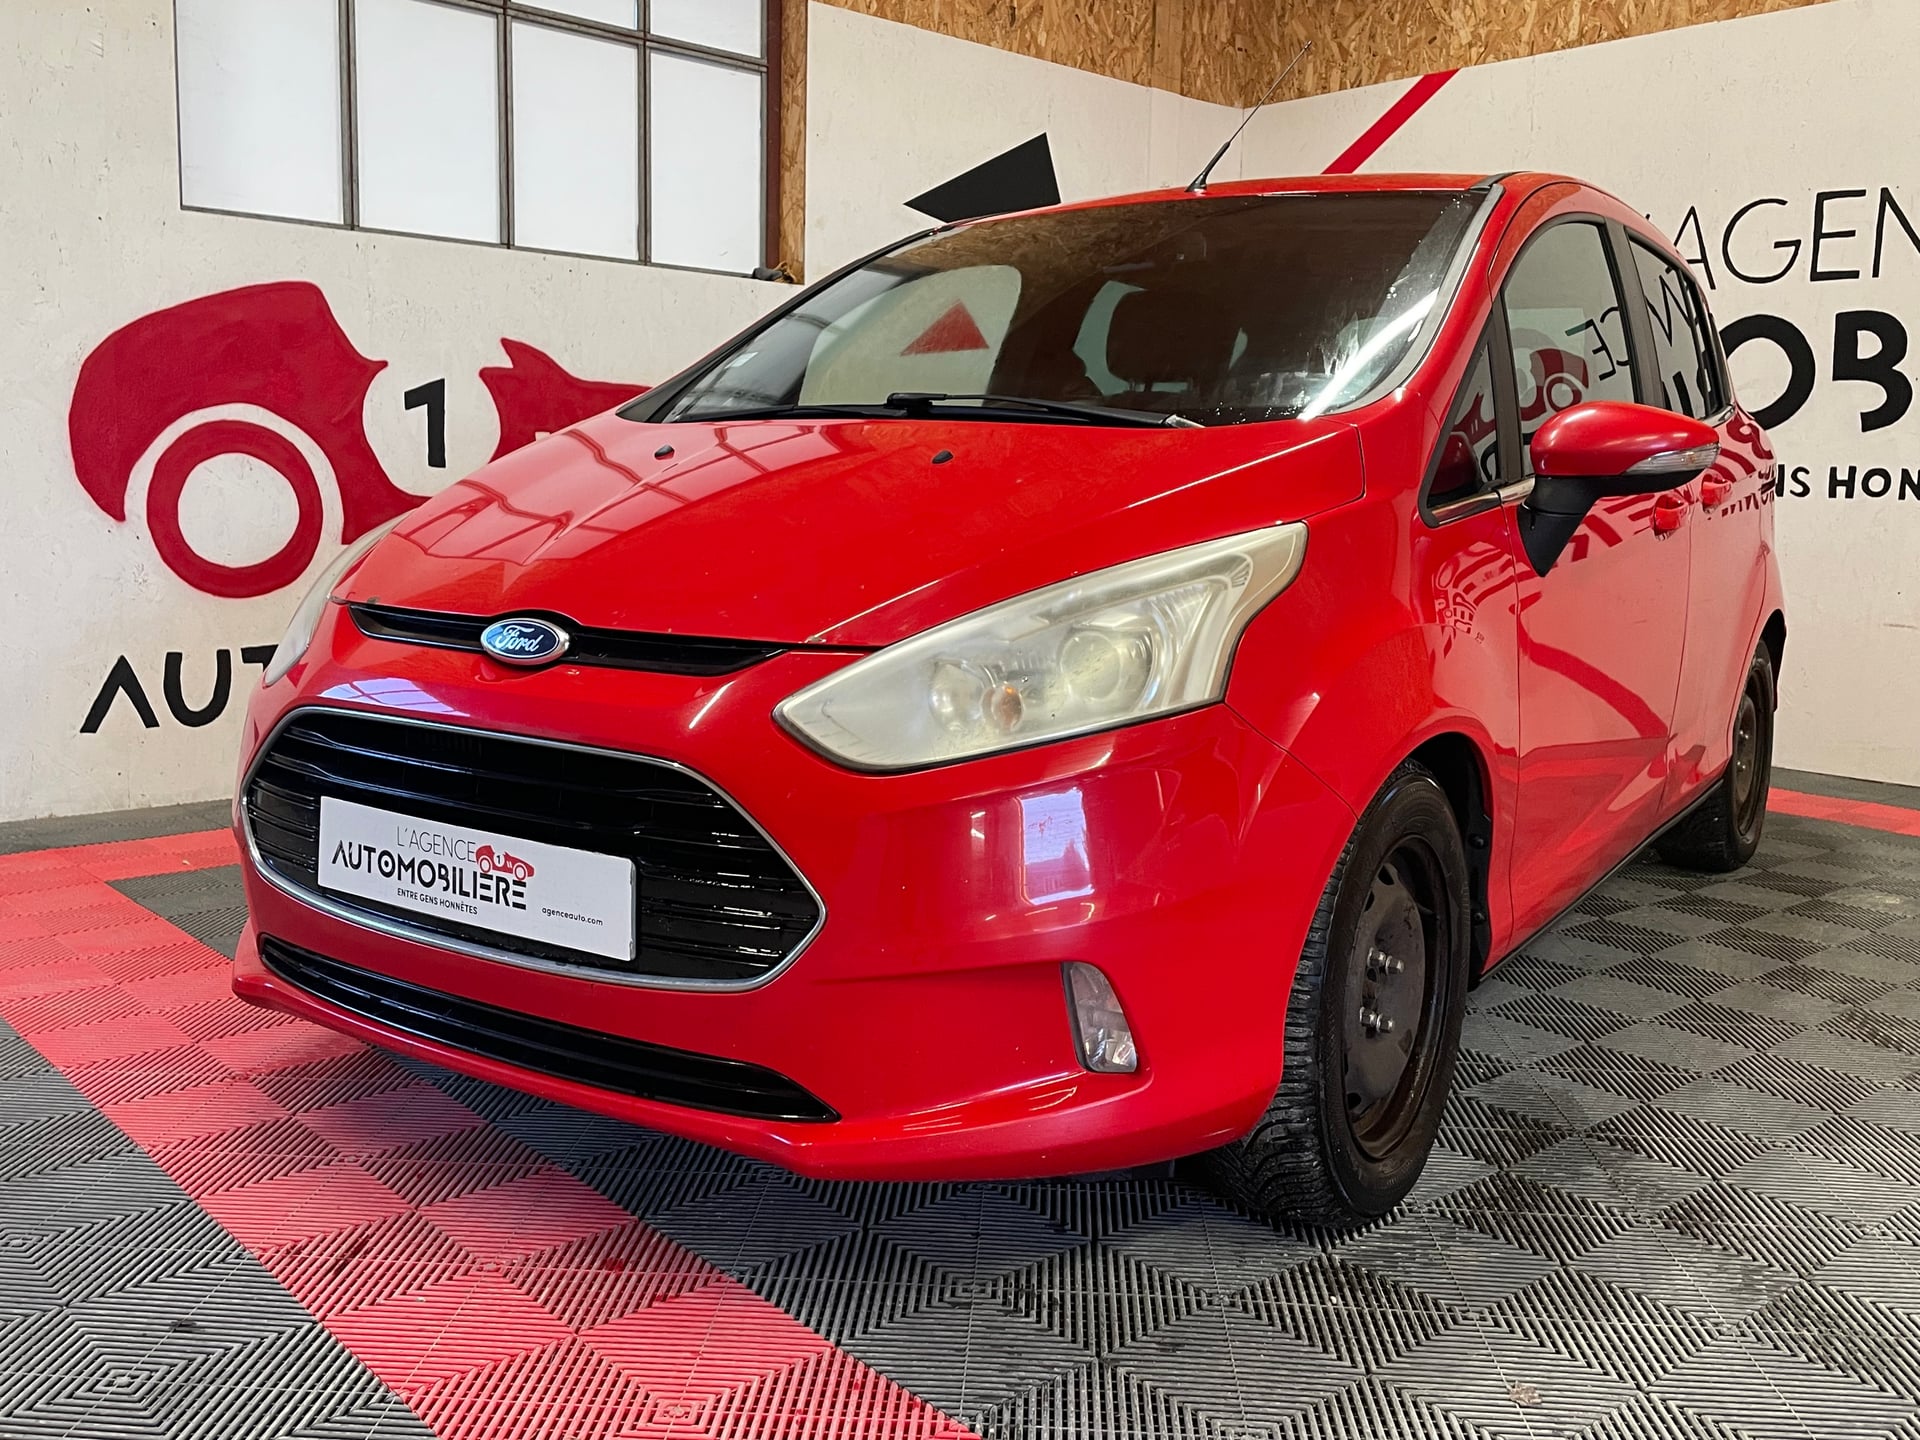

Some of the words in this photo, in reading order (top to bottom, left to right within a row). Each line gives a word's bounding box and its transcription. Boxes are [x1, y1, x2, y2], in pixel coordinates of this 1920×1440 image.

[1645, 187, 1920, 290] AGEN
[403, 377, 446, 468] 1
[494, 624, 545, 652] Ford
[396, 825, 477, 864] L'AGENCE
[397, 887, 419, 901] ENTRE
[419, 893, 438, 906] GENS
[541, 906, 604, 926] agenceauto.com
